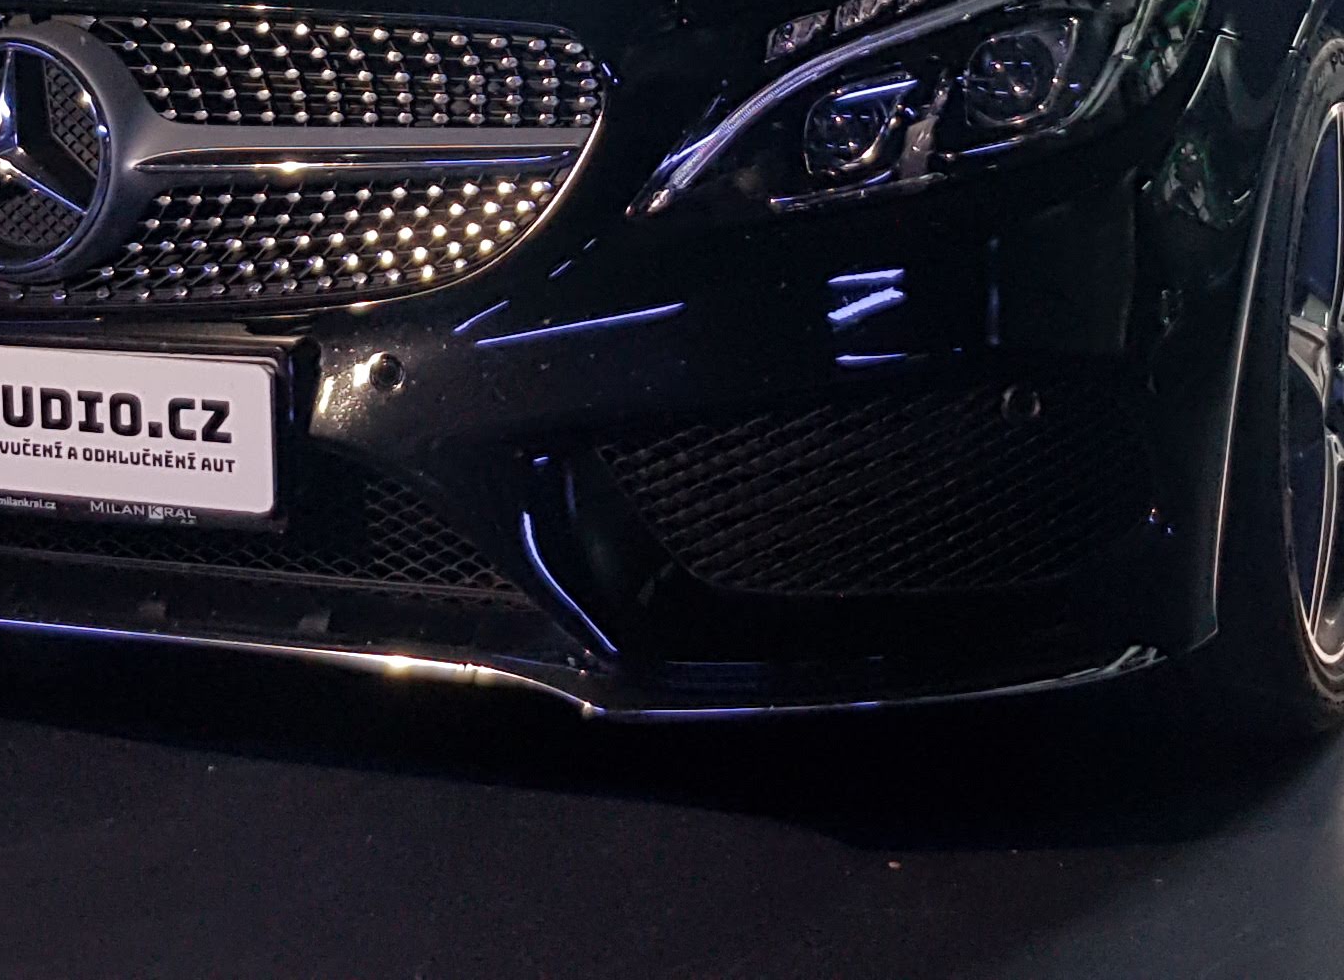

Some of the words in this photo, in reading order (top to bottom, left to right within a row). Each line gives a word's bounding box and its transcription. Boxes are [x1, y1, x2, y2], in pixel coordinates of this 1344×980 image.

[67, 446, 78, 460] A
[83, 448, 196, 470] ODHLUČNĚNÍ
[201, 457, 236, 473] AUT
